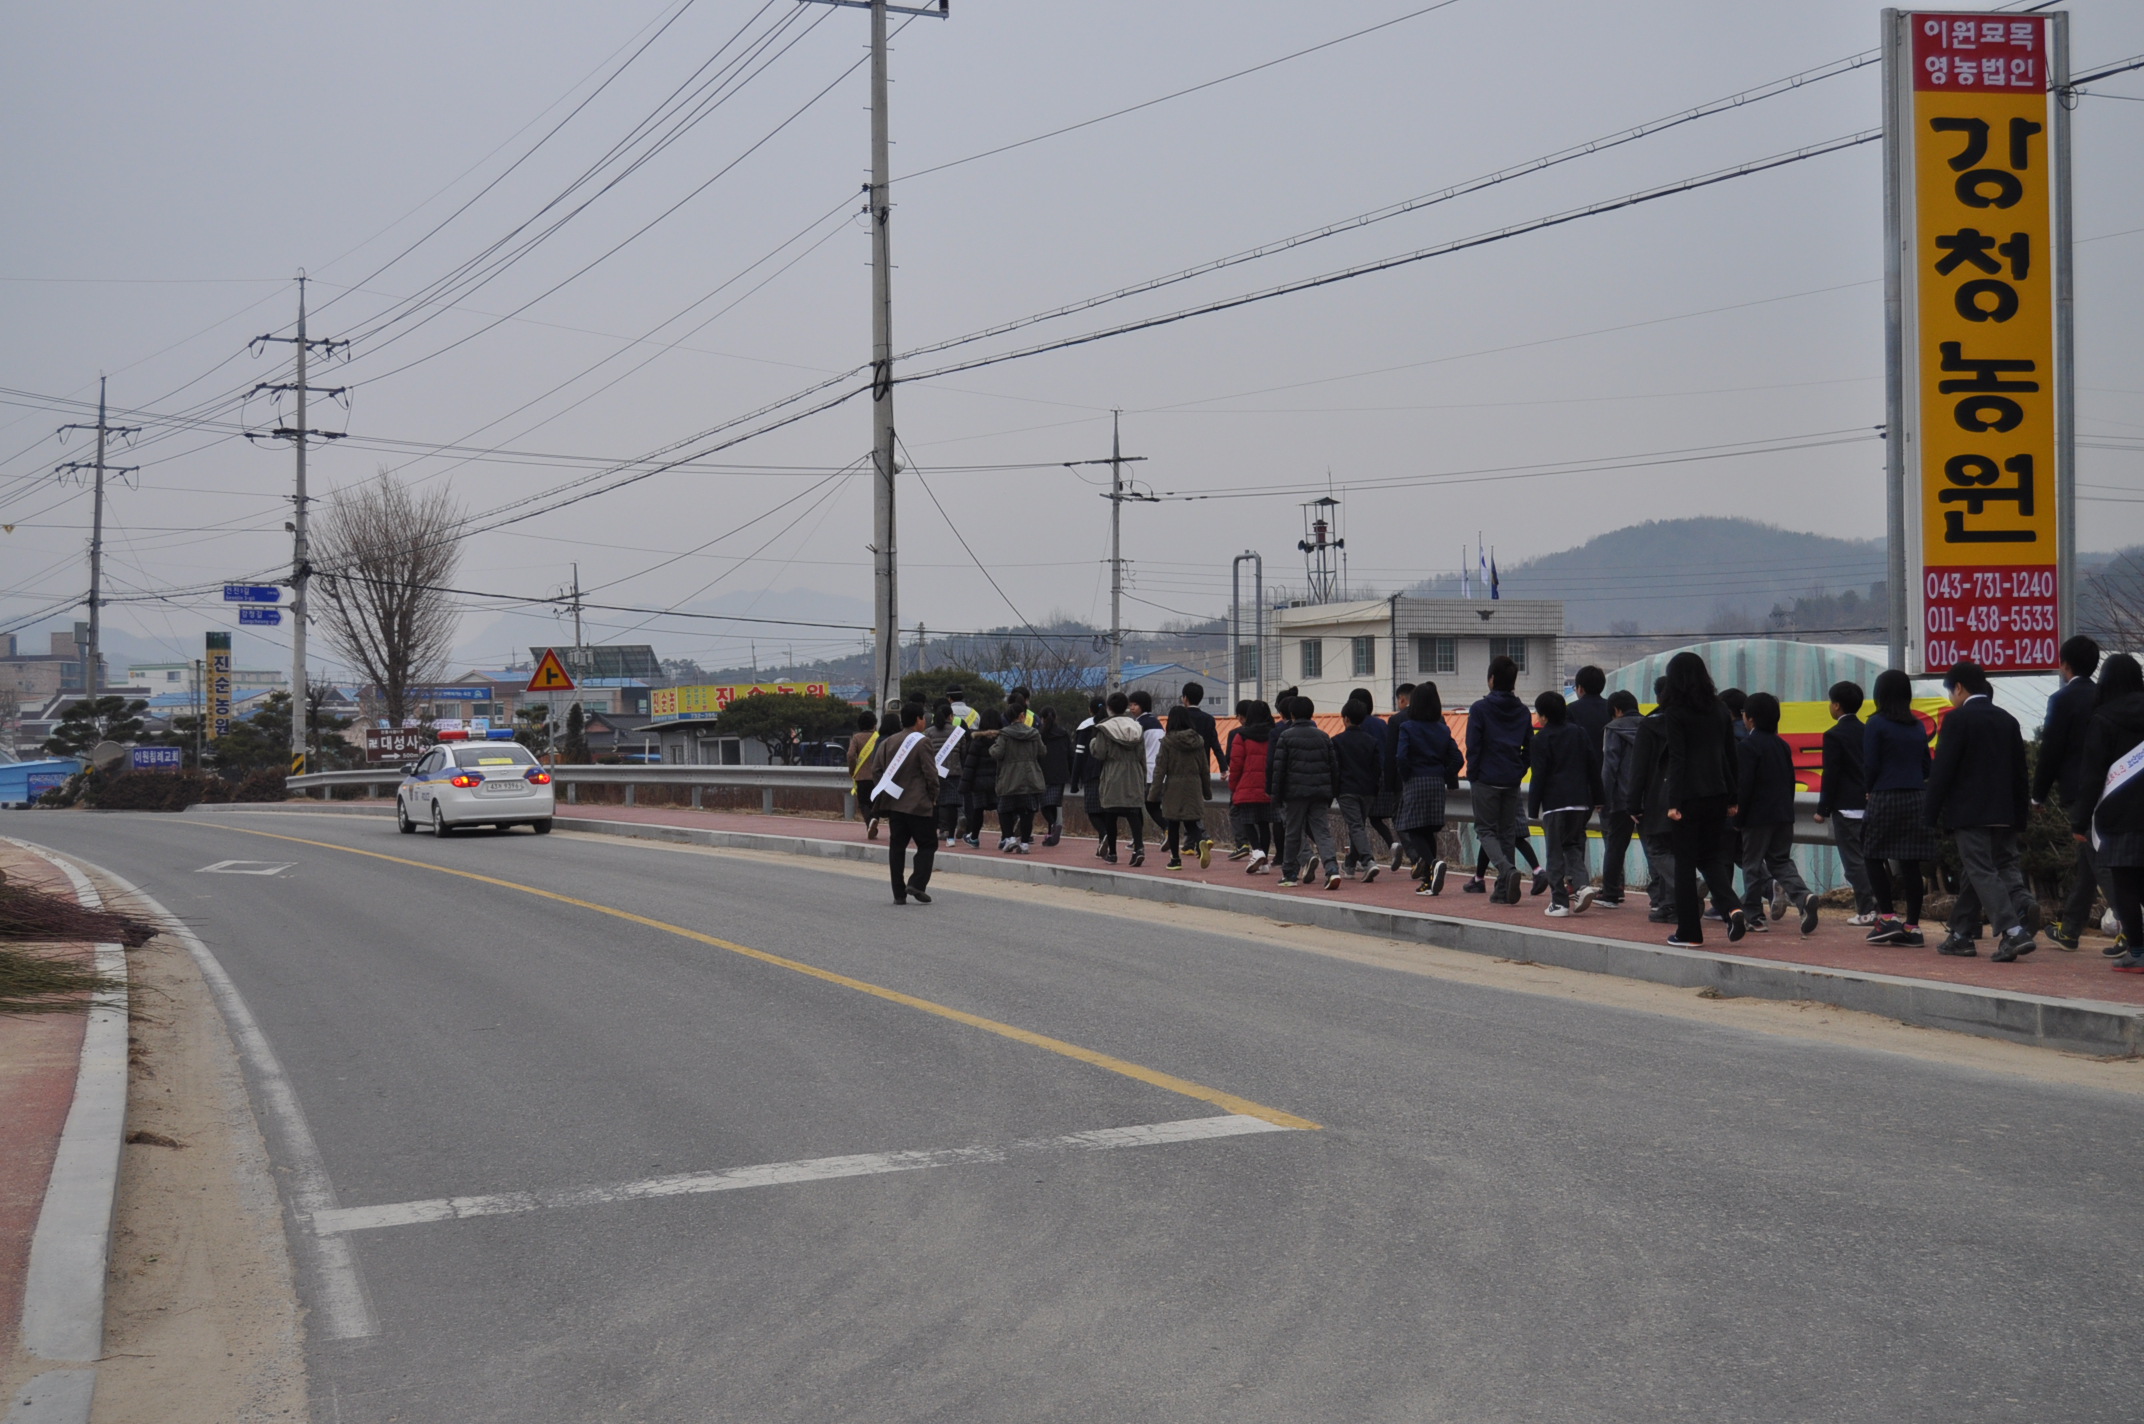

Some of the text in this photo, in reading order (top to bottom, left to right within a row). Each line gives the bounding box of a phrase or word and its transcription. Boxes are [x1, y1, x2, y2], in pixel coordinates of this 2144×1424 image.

[1924, 20, 2034, 51] 이원묘목
[1925, 55, 2035, 87] 영농법인
[1929, 116, 2042, 543] 강청농원
[1926, 571, 2053, 599] 043-731-1240
[1927, 605, 2054, 633] 011-438-5533
[1928, 638, 2055, 666] 016-405-1240
[213, 655, 230, 737] 진순농원
[134, 750, 179, 764] 이원침례교회
[380, 735, 419, 751] 대성사
